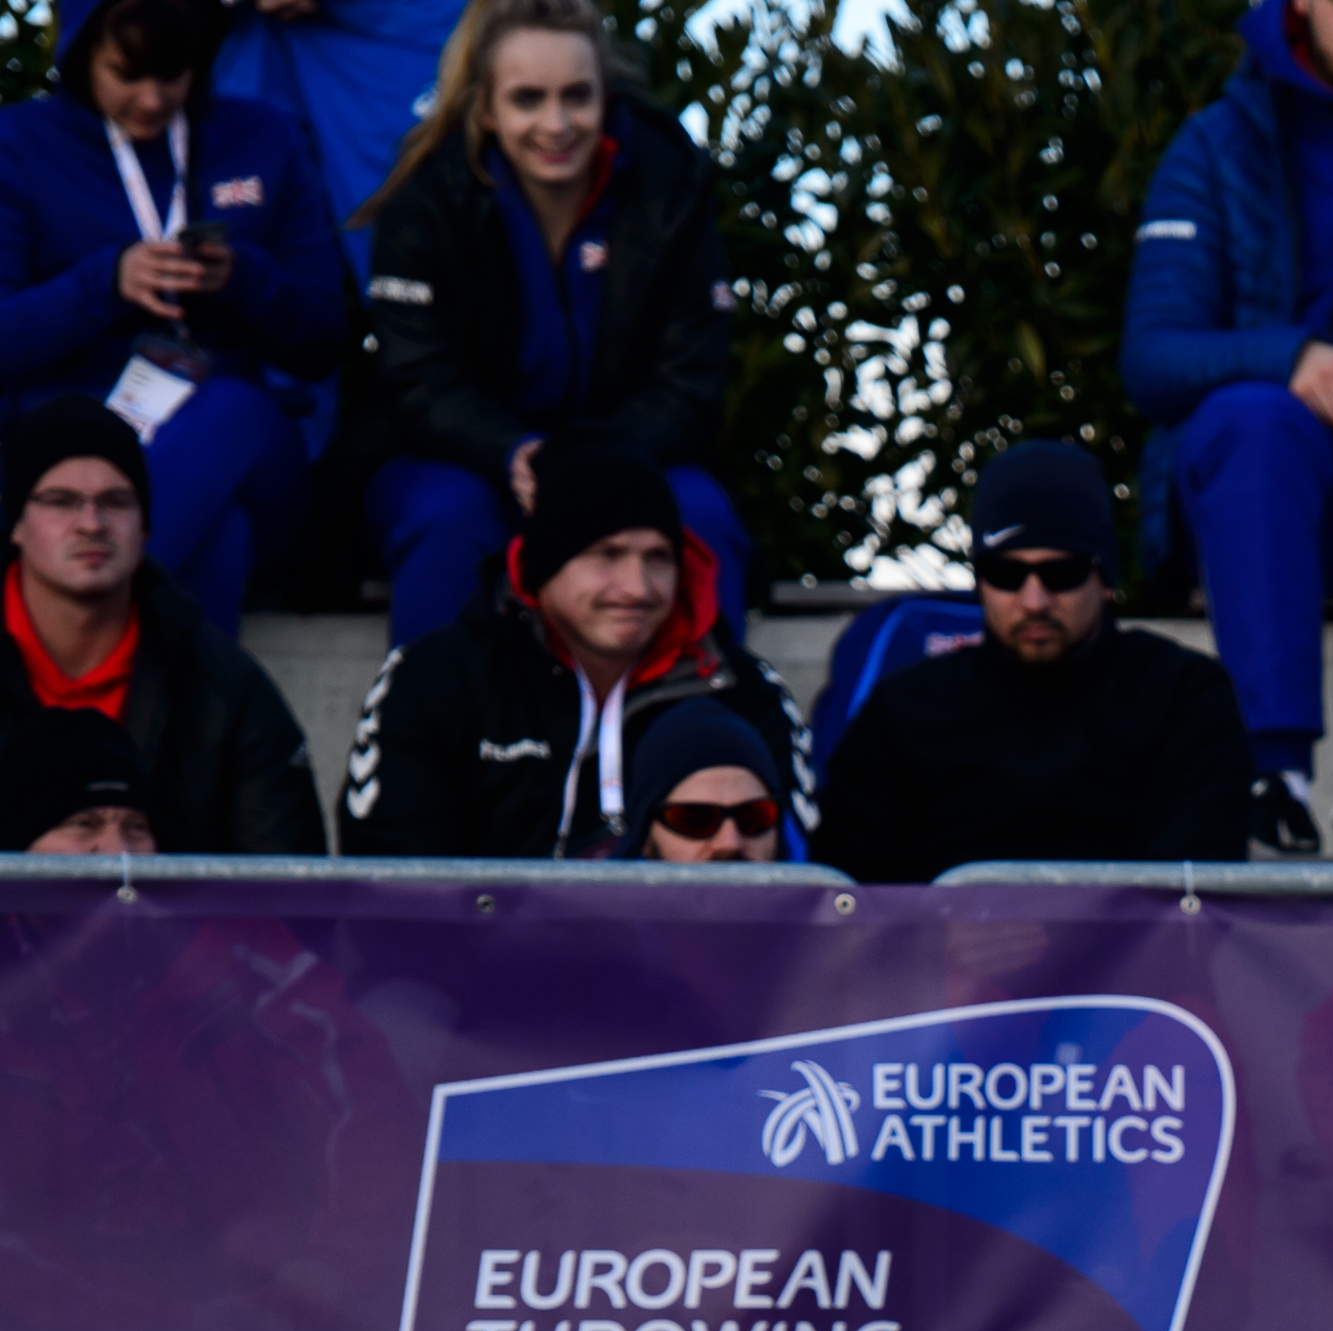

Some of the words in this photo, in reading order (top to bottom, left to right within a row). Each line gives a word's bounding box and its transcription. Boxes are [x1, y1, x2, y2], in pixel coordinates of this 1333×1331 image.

[872, 1062, 1185, 1111] EUROPEAN
[871, 1114, 1185, 1164] ATHLETICS
[474, 1248, 891, 1310] EUROPEAN
